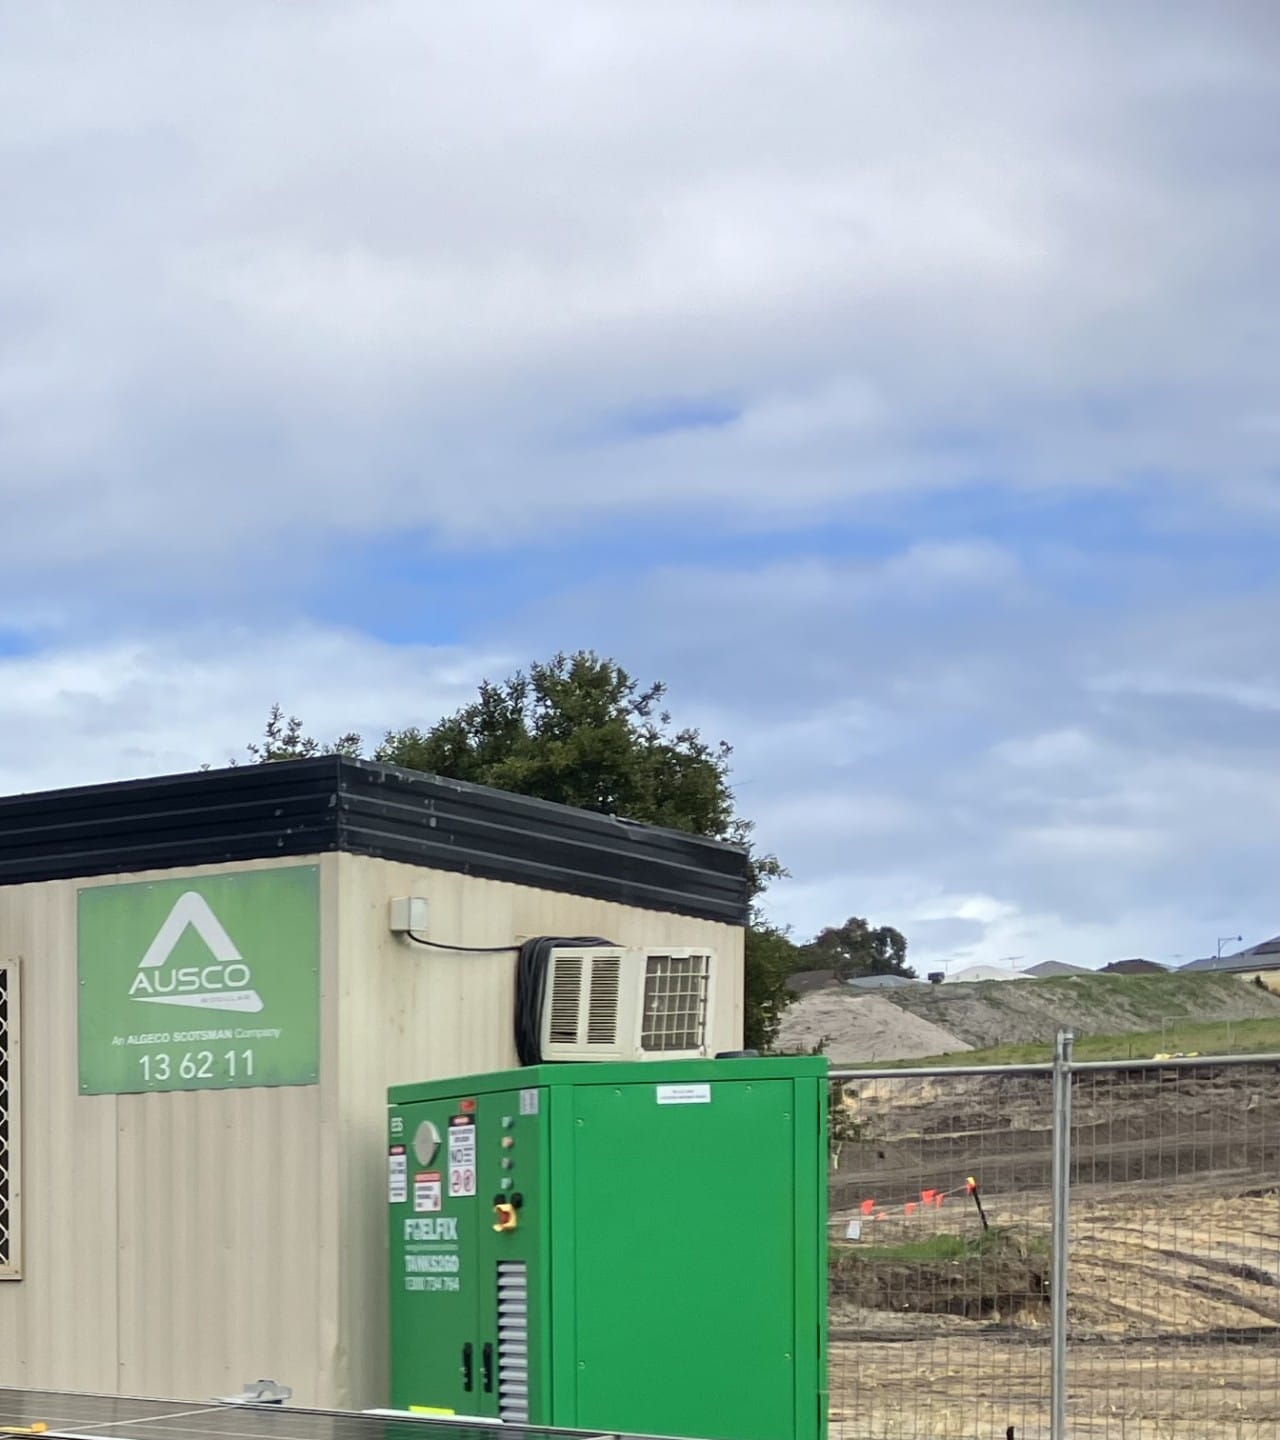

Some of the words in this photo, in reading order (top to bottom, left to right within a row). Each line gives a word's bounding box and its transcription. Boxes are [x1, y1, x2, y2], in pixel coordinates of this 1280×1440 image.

[128, 964, 251, 995] AUSCO
[112, 1036, 125, 1046] An
[127, 1032, 170, 1045] ALGECO
[172, 1029, 232, 1042] SCOTSMAN
[234, 1027, 281, 1039] Company
[139, 1053, 170, 1081] 13
[179, 1051, 213, 1079] 62
[224, 1049, 253, 1076] 11
